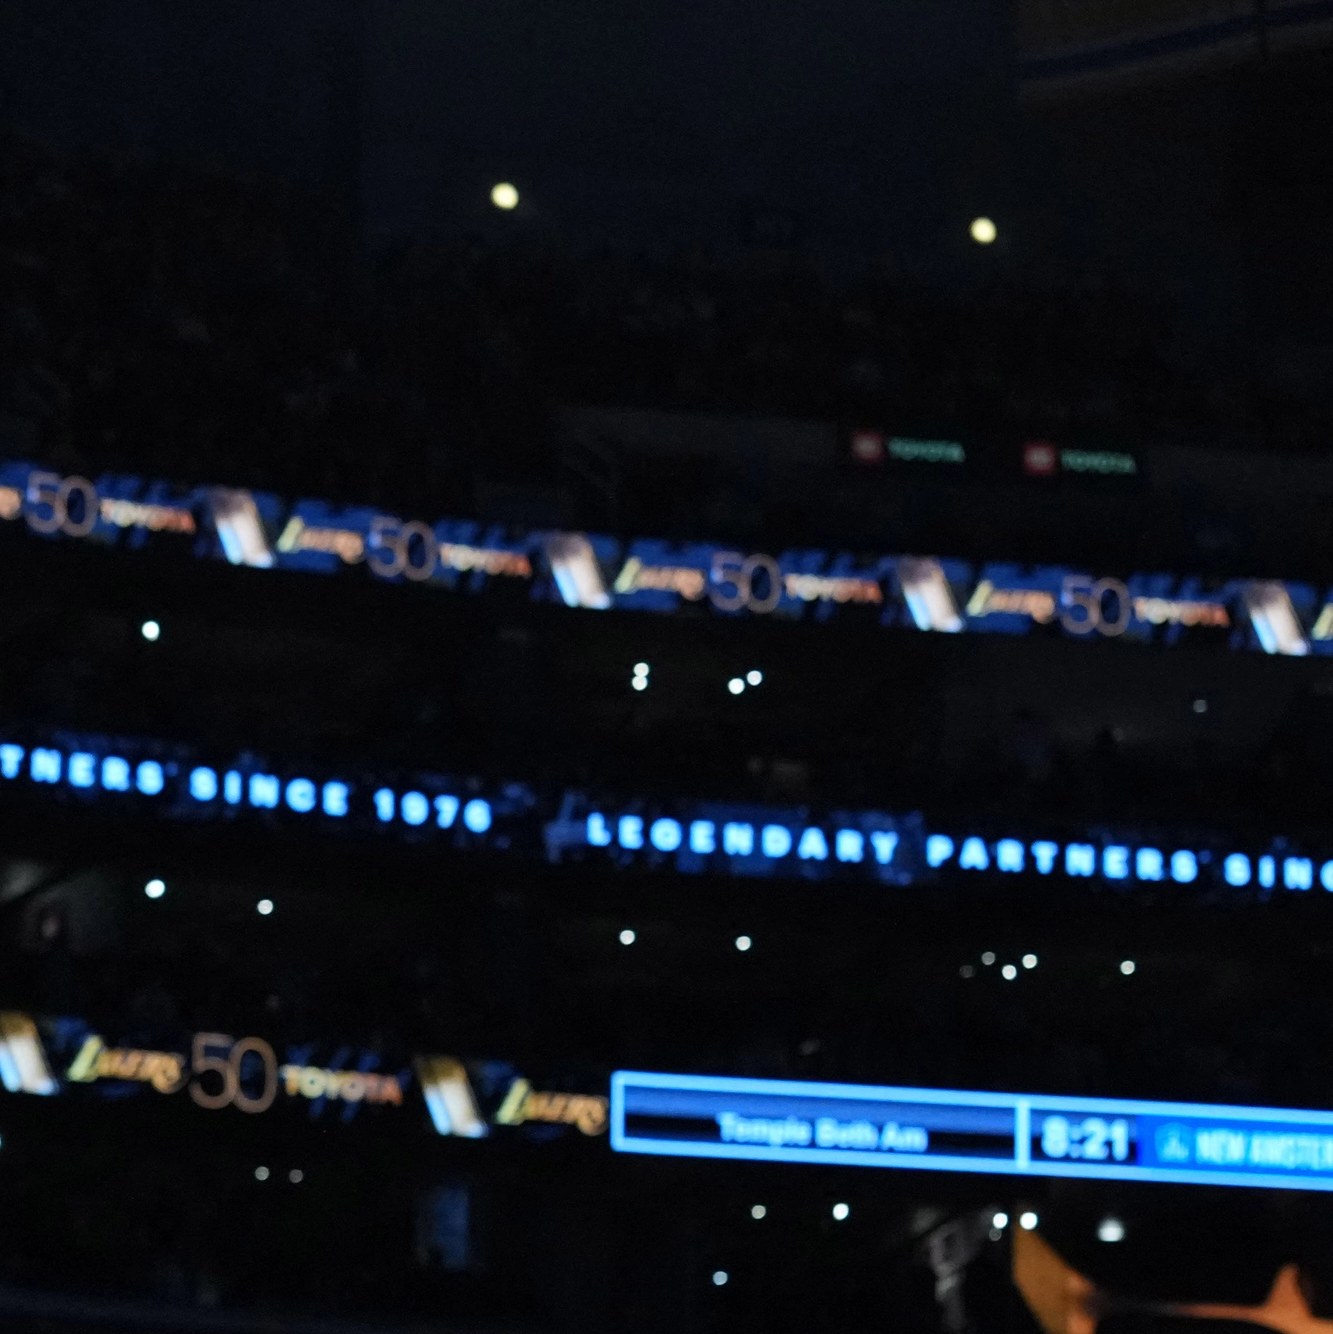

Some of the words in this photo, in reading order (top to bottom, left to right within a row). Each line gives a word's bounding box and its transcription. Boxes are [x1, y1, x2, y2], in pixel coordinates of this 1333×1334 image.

[24, 469, 99, 538] 50
[367, 515, 435, 581] 50
[709, 551, 782, 614] 50
[1059, 574, 1132, 636] 50
[189, 766, 349, 817] SINCE
[586, 812, 899, 865] LEGENDARY
[925, 834, 1198, 883] PARTNERS
[188, 1032, 279, 1114] 50
[1040, 1114, 1129, 1161] 8:21
